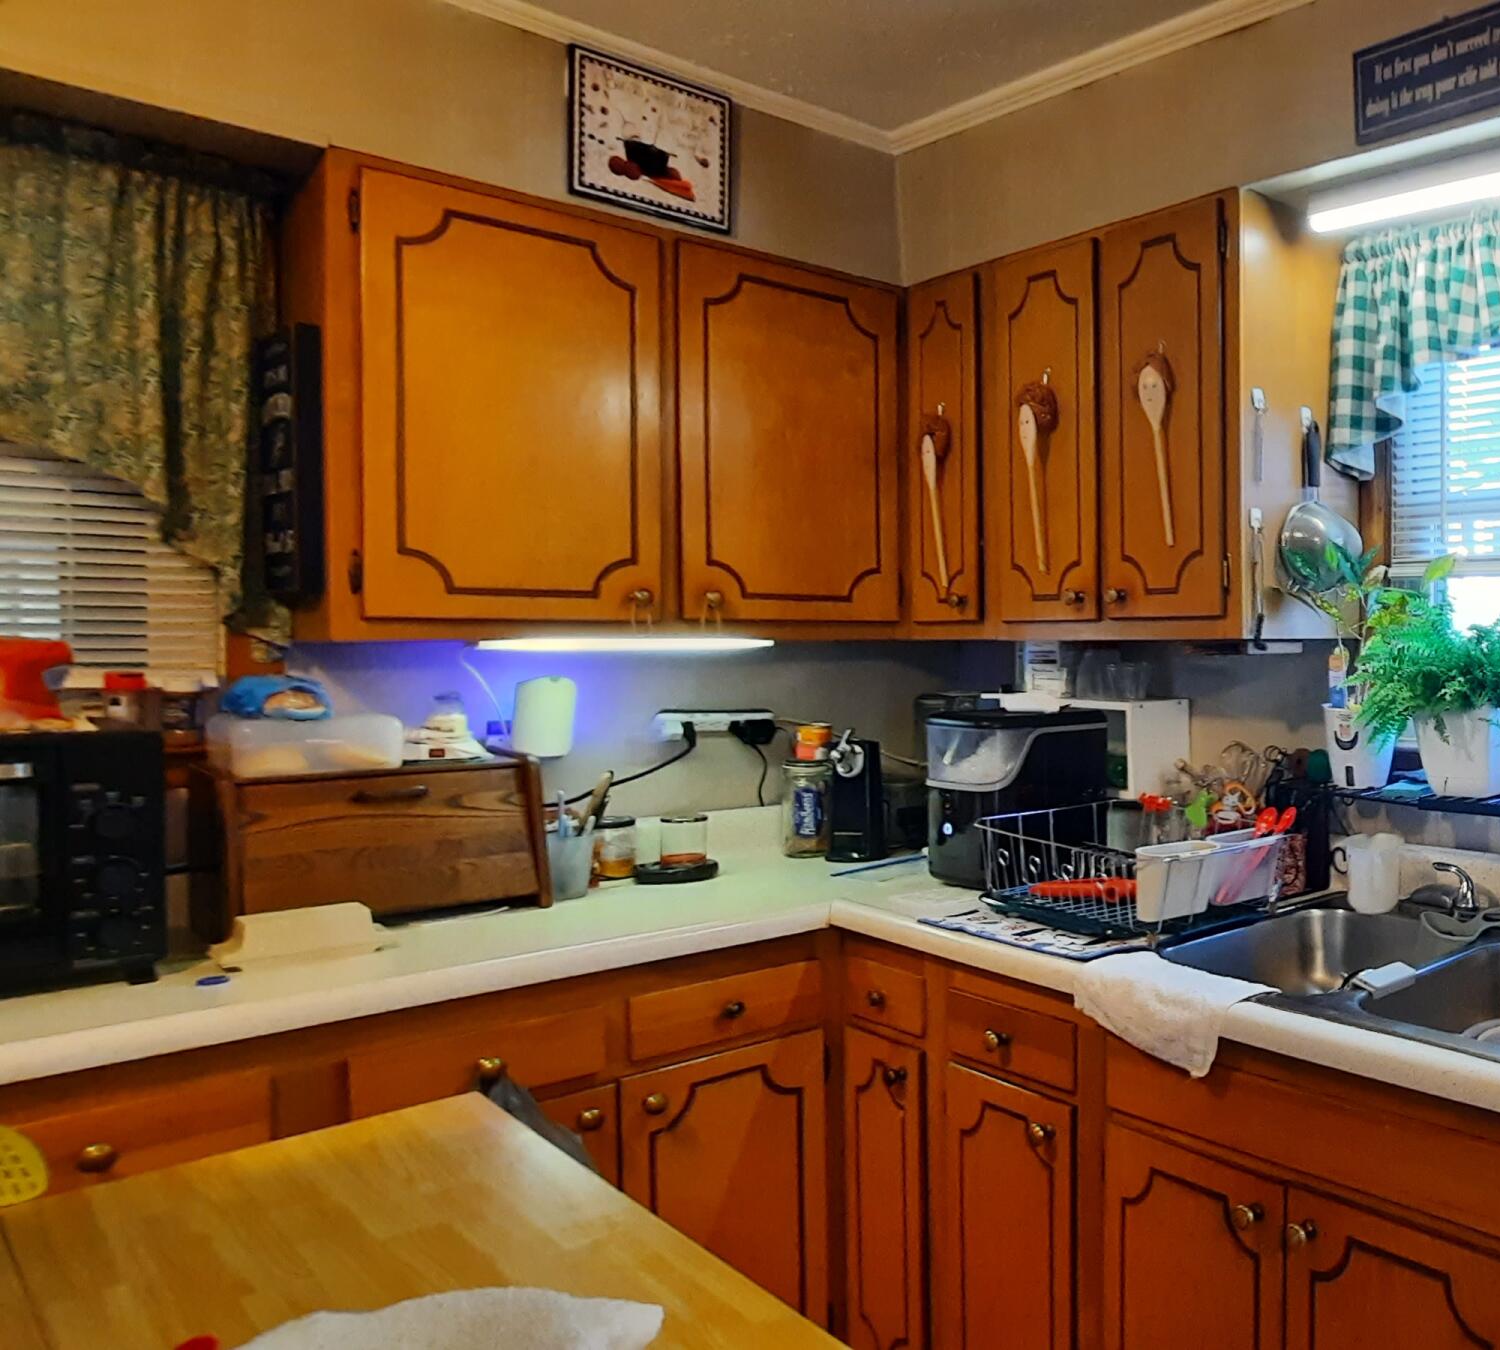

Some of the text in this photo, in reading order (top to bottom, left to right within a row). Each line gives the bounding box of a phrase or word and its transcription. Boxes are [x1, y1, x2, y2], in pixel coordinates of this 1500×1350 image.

[1374, 62, 1383, 84] If
[1383, 64, 1393, 81] at
[1394, 56, 1412, 78] first
[1413, 53, 1430, 76] you
[1431, 39, 1454, 65] don't
[1455, 25, 1490, 56] succeed
[1366, 96, 1389, 118] doing
[1391, 90, 1398, 110] it
[1399, 86, 1413, 108] the
[1414, 83, 1433, 104] way
[1434, 76, 1457, 100] your
[1458, 63, 1478, 88] wife
[1479, 56, 1498, 81] told
